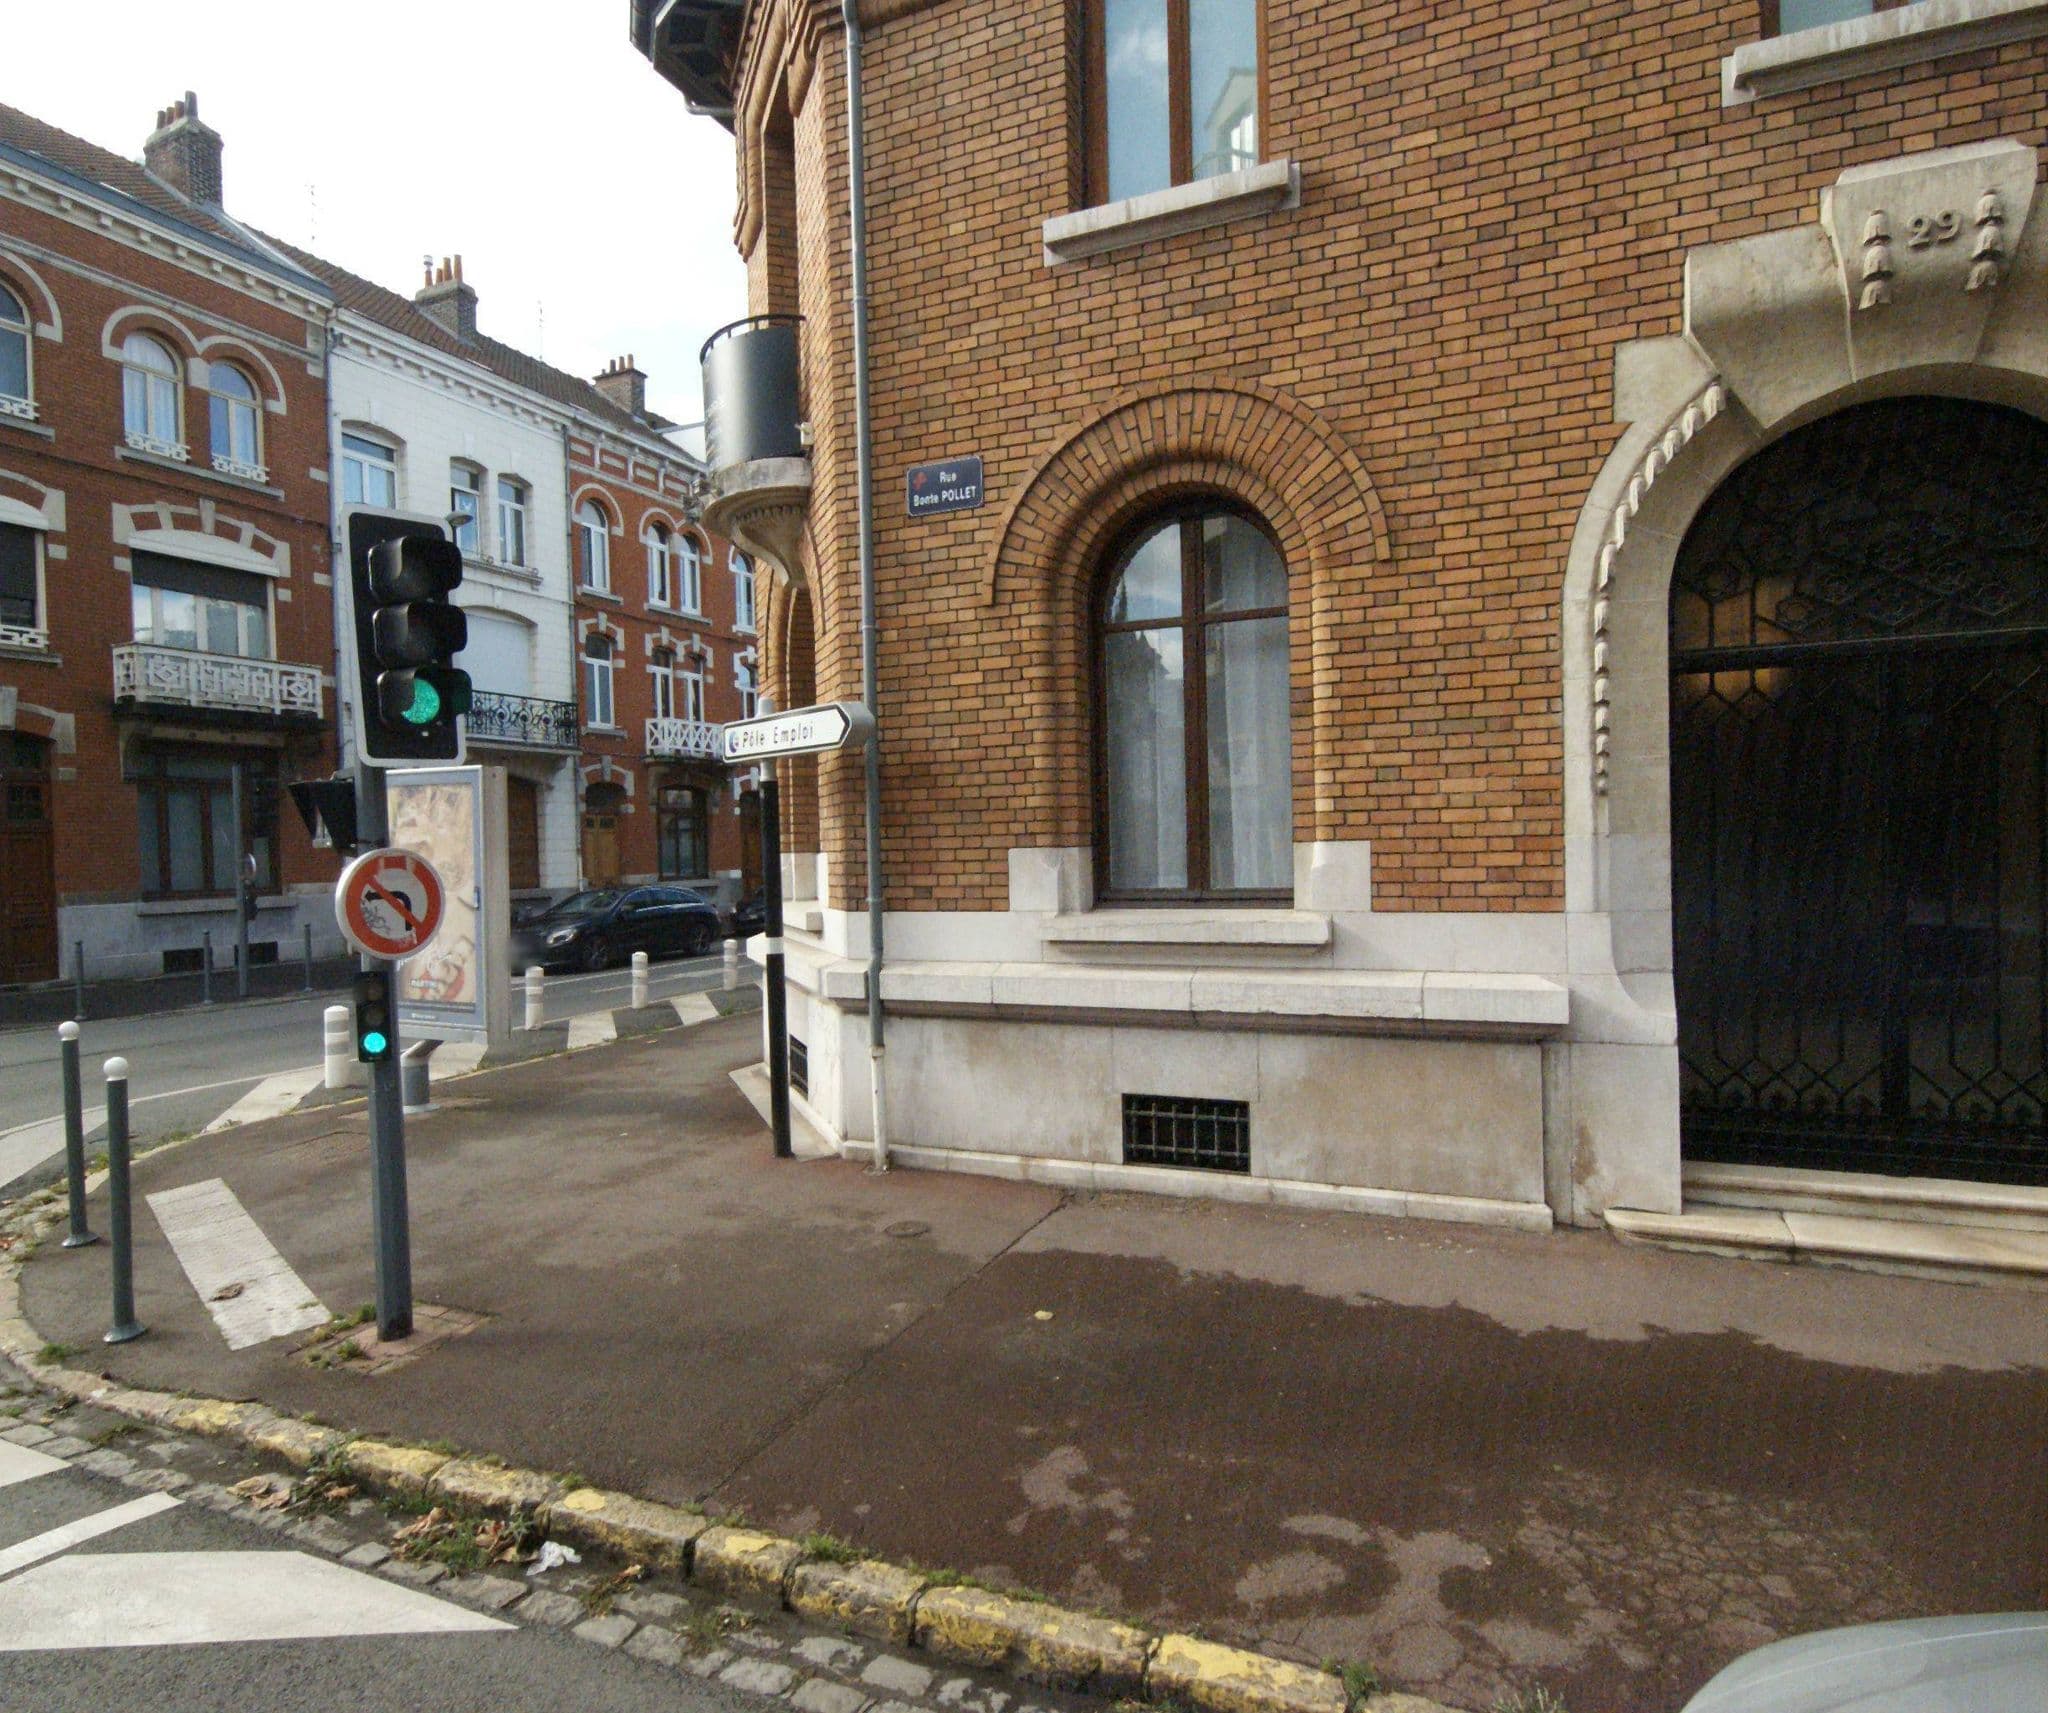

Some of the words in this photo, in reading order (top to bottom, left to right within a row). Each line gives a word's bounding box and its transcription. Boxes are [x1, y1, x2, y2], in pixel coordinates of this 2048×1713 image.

[1907, 208, 1963, 249] 29
[940, 471, 957, 482] Rue
[941, 486, 976, 502] POLLET
[743, 729, 765, 748] Pôle
[773, 720, 815, 745] Emploi
